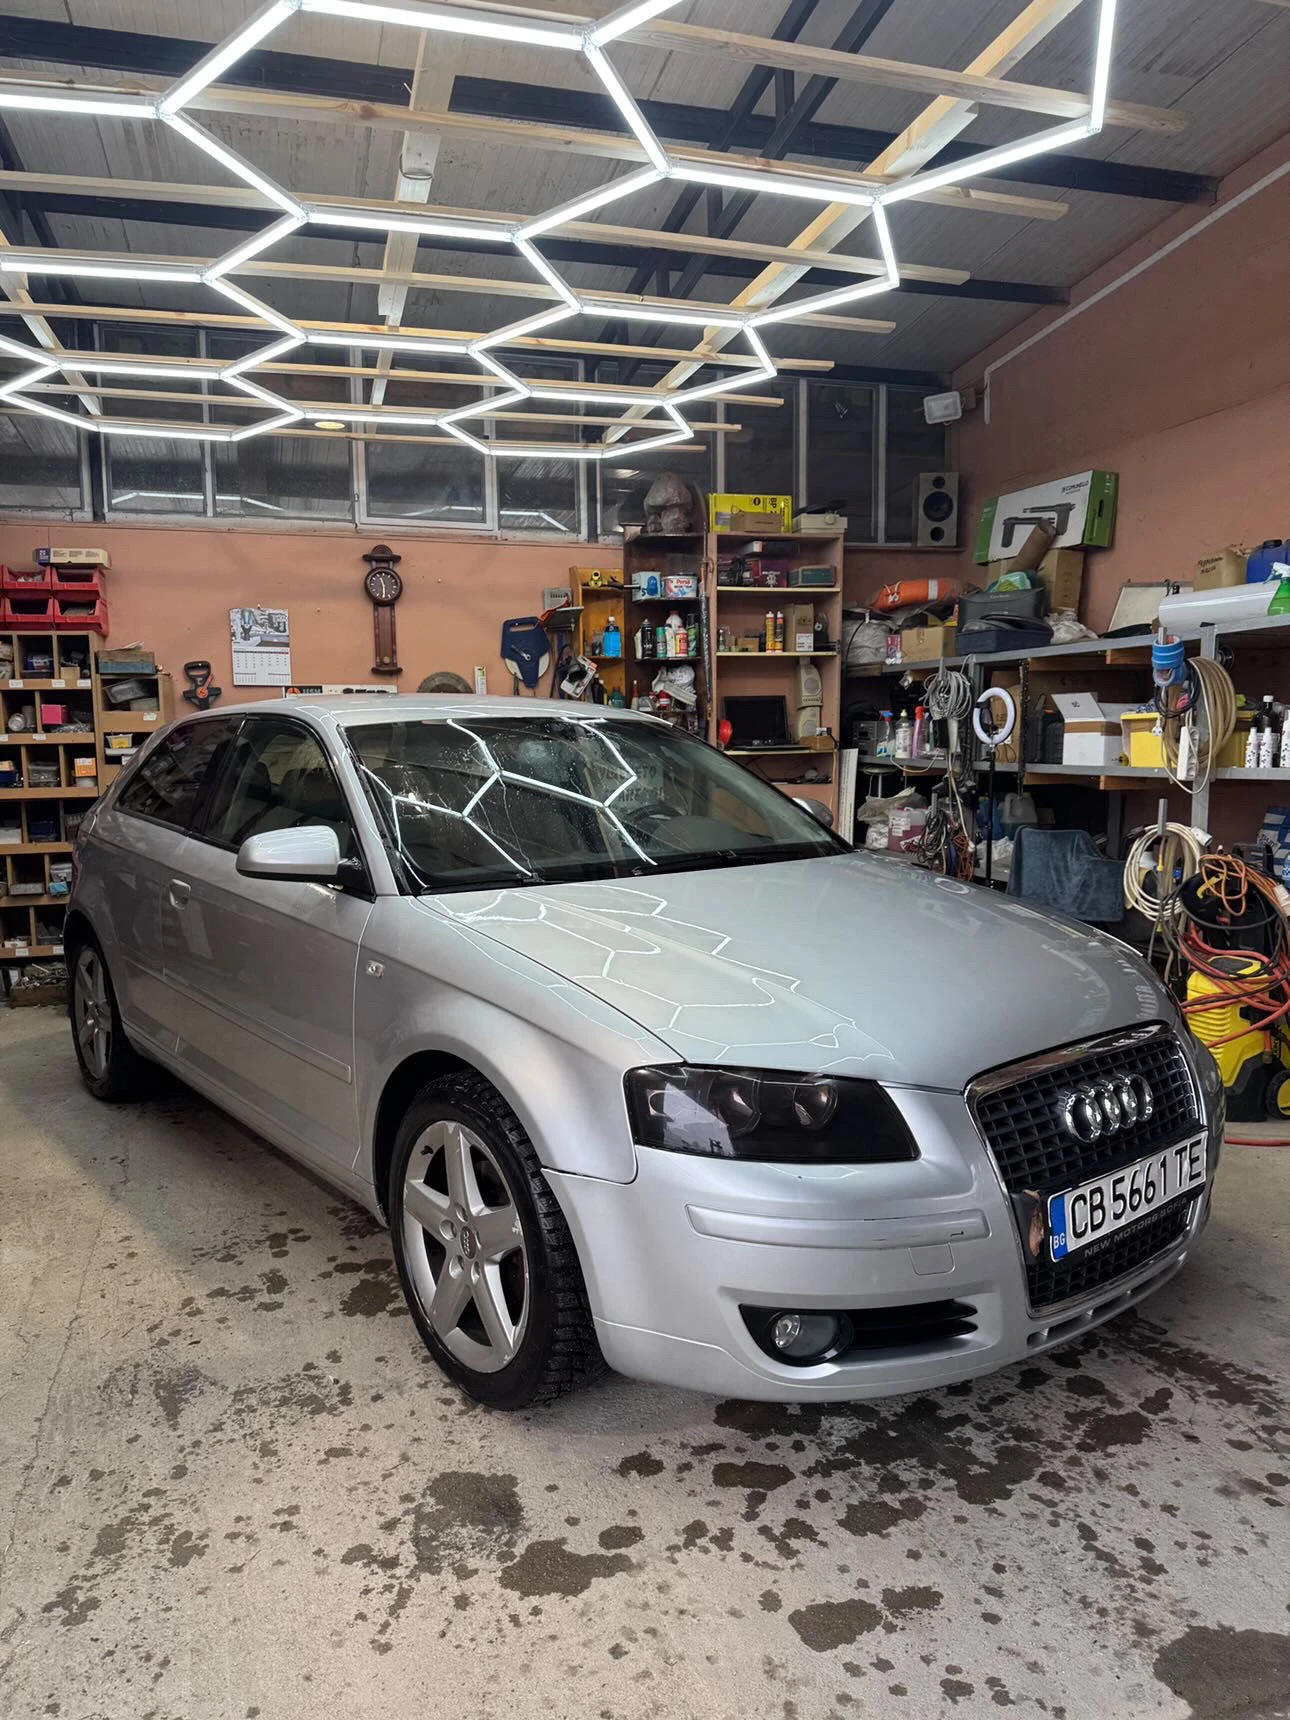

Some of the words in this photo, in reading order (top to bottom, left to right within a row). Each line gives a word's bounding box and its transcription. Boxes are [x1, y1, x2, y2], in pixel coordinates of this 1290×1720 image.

[1070, 1186, 1106, 1240] CB
[1111, 1155, 1167, 1220] 5661
[1174, 1139, 1202, 1187] TE
[1053, 1232, 1066, 1249] BG
[1084, 1240, 1112, 1258] NEW
[1114, 1214, 1158, 1242] MOTORS
[1157, 1196, 1188, 1218] SOFIA
